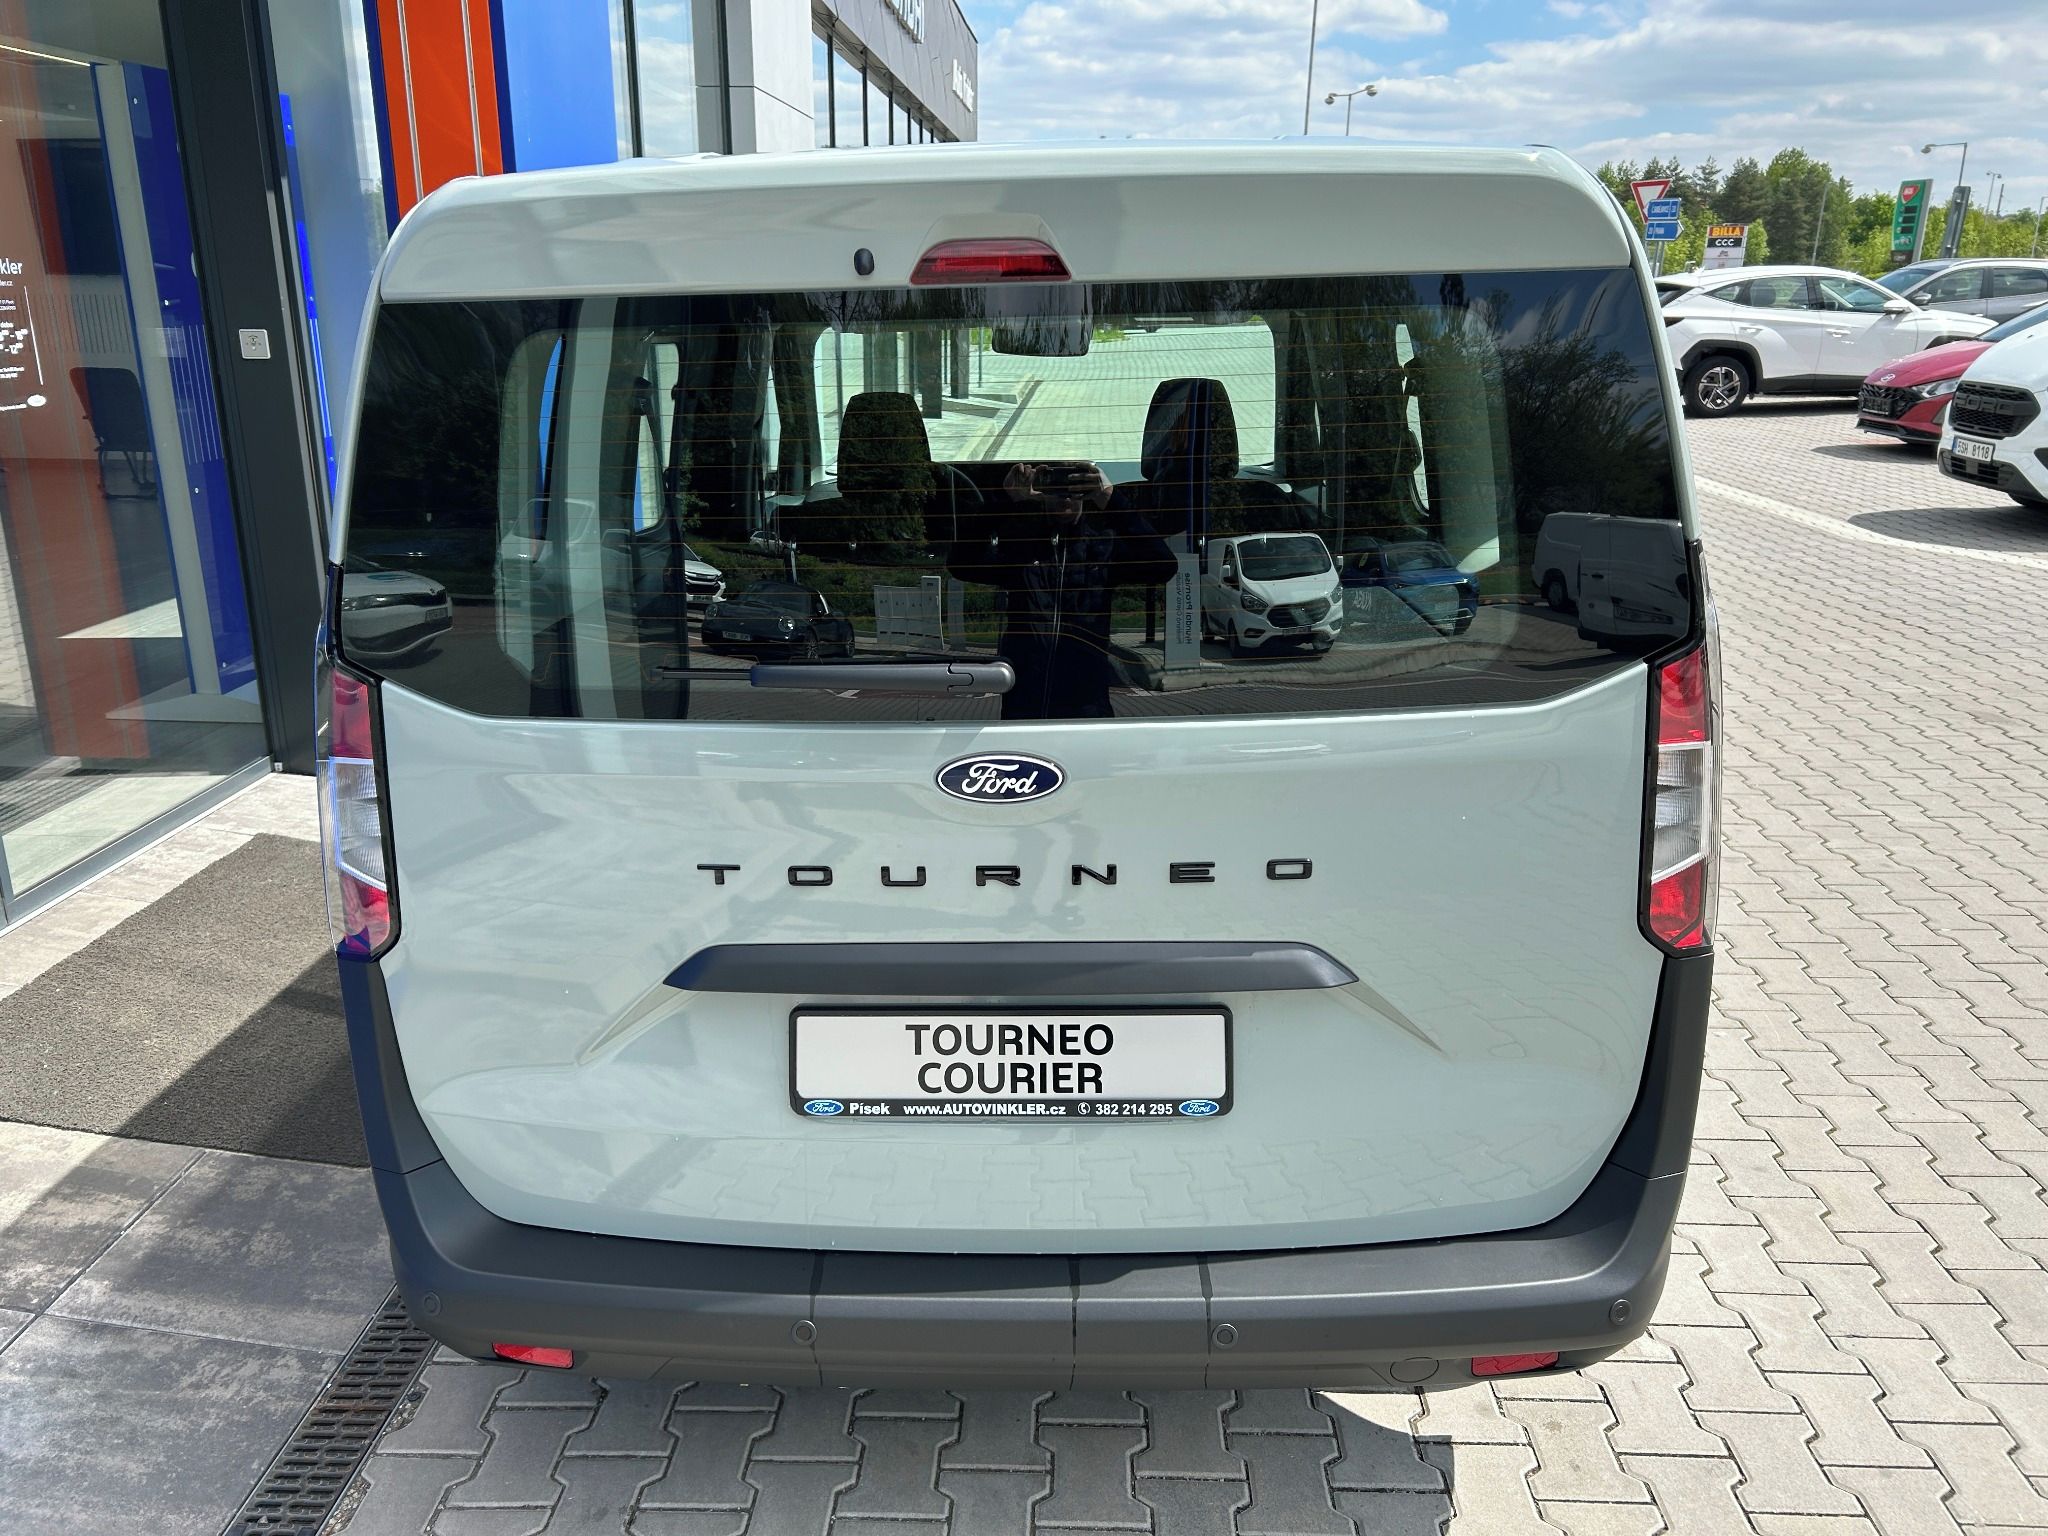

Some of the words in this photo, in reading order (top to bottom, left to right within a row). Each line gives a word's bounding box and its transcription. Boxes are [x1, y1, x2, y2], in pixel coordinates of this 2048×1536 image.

[1712, 226, 1740, 236] BILLA
[1972, 444, 1990, 460] 8118
[961, 763, 1039, 794] Ford
[696, 857, 1313, 888] TOURNEO
[905, 1023, 1114, 1056] TOURNEO
[917, 1062, 1103, 1094] COURIER
[849, 1102, 890, 1115] Písek
[903, 1103, 1067, 1115] www.AUTOVINKLER.cz
[1095, 1103, 1119, 1115] 382
[1122, 1103, 1146, 1115] 214
[1149, 1103, 1173, 1115] 295
